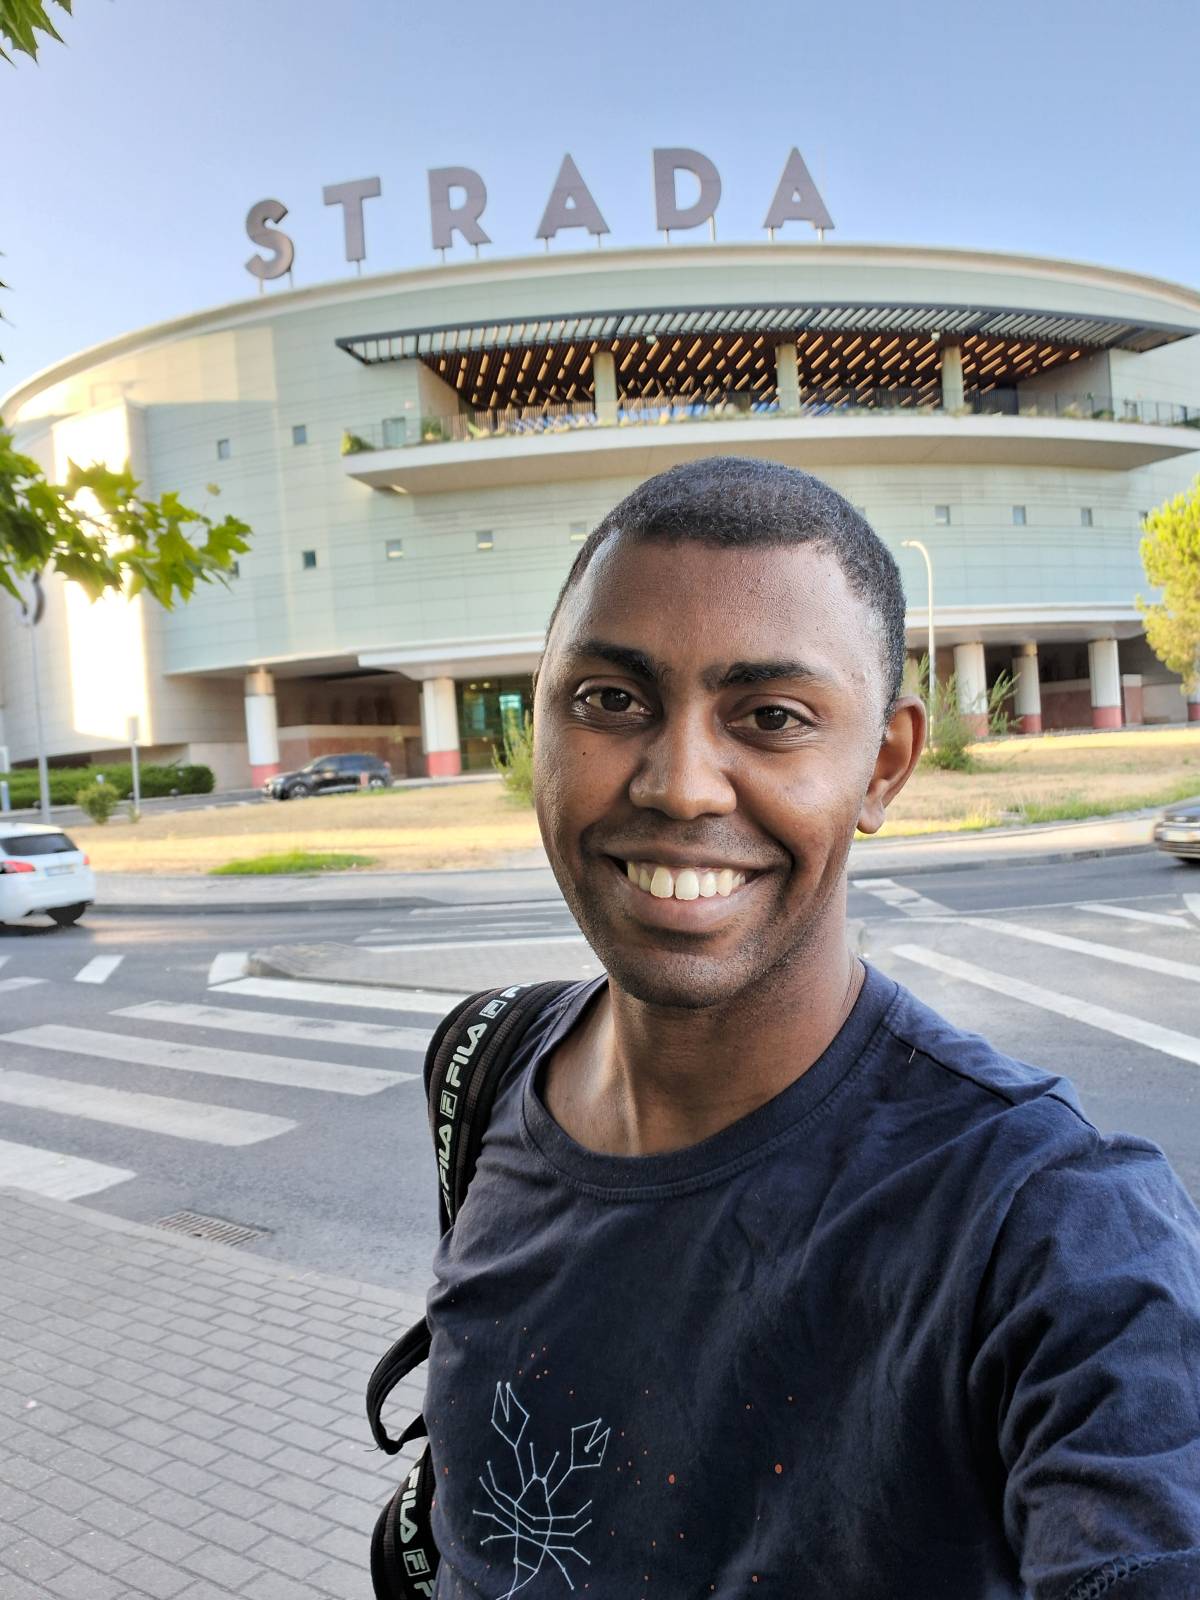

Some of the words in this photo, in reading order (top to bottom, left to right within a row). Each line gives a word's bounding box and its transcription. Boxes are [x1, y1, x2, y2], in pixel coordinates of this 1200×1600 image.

[245, 147, 835, 280] STRADA
[446, 1023, 487, 1088] FILA
[438, 1124, 452, 1191] FILA
[400, 1466, 420, 1543] FILA
